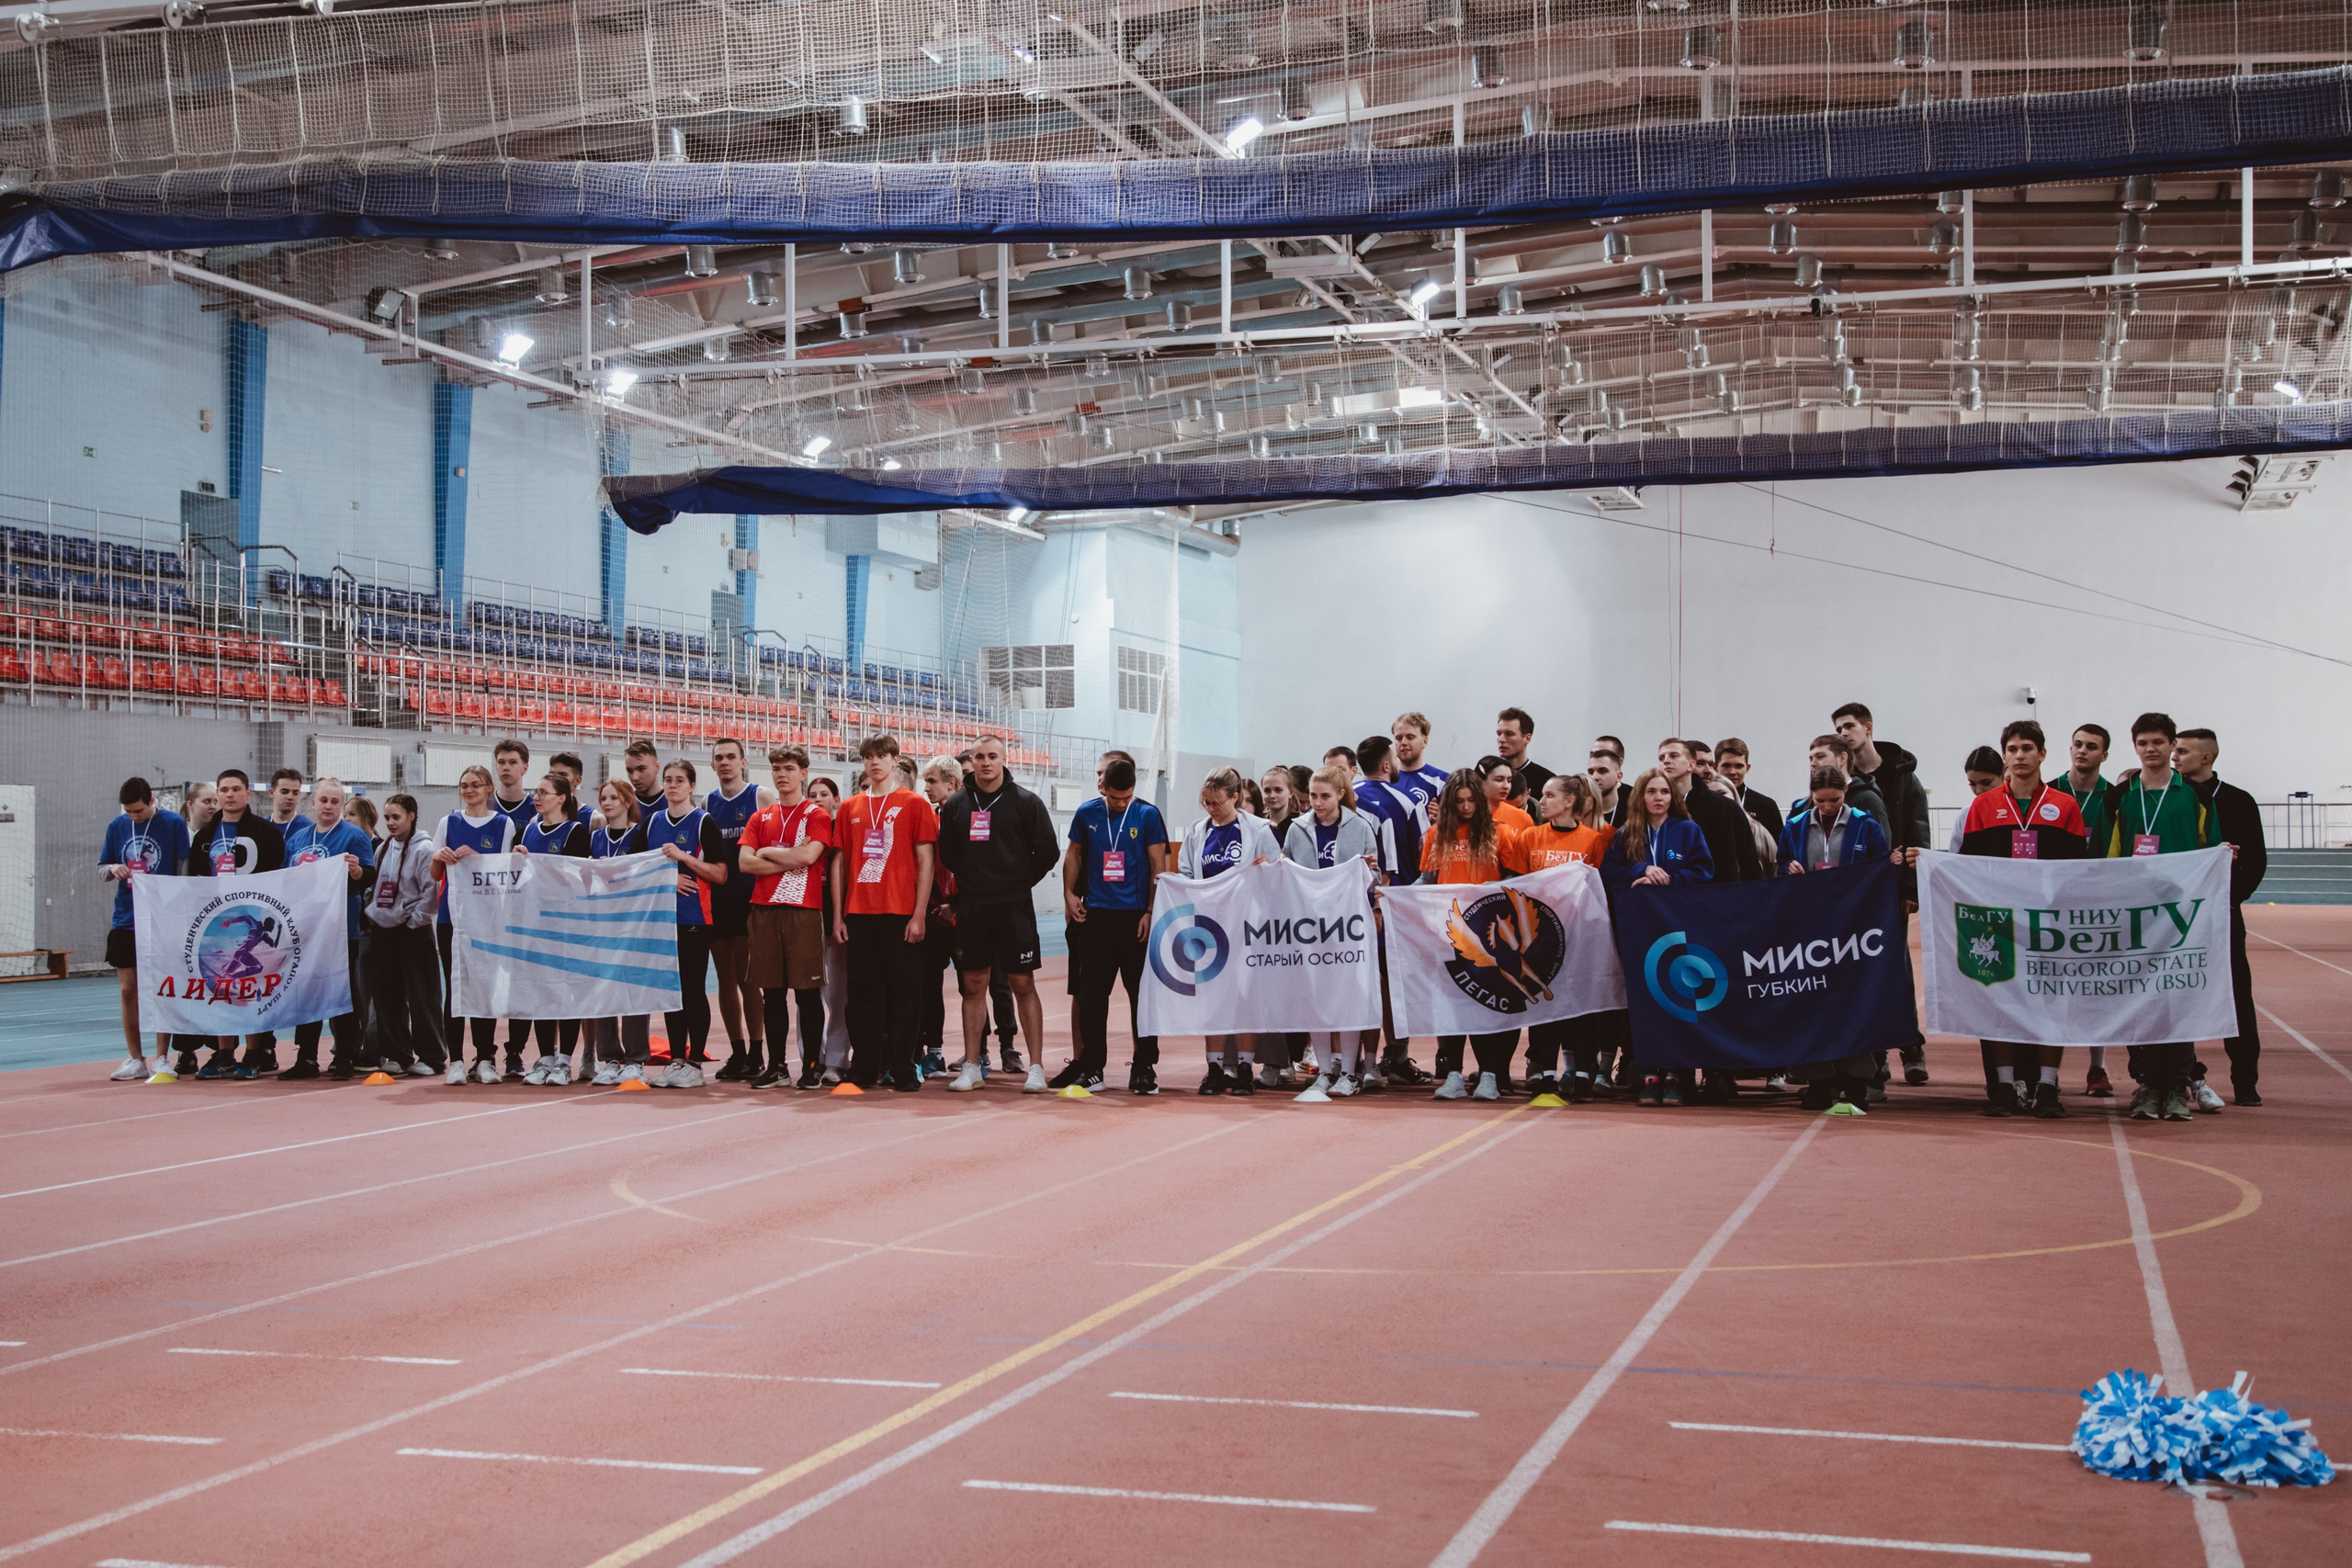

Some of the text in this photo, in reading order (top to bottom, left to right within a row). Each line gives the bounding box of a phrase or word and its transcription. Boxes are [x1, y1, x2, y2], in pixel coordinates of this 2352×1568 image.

[471, 870, 522, 886] БГТУ
[1463, 894, 1507, 921] СТУДЕНЧЕСКИЙ
[1958, 906, 2008, 924] БелГУ
[2068, 908, 2122, 926] НИУ
[185, 896, 223, 974] СТУДЕНЧЕСКИЙ
[224, 891, 291, 918] СПОРТИВНЫЙ
[286, 917, 301, 945] КЛУБ
[1244, 914, 1365, 946] МИСИС
[2023, 897, 2206, 953] БелГУ
[1246, 949, 1365, 967] СТАРЫЙ ОСКОЛ
[1742, 928, 1883, 977] МИСИС
[2026, 952, 2208, 977] BELGOROD STATE
[156, 974, 282, 1006] ЛИДЕР
[1454, 970, 1510, 1011] ПЕГАС
[1747, 975, 1827, 999] ГУБКИН
[2026, 970, 2208, 997] UNIVERSITY (BSU)
